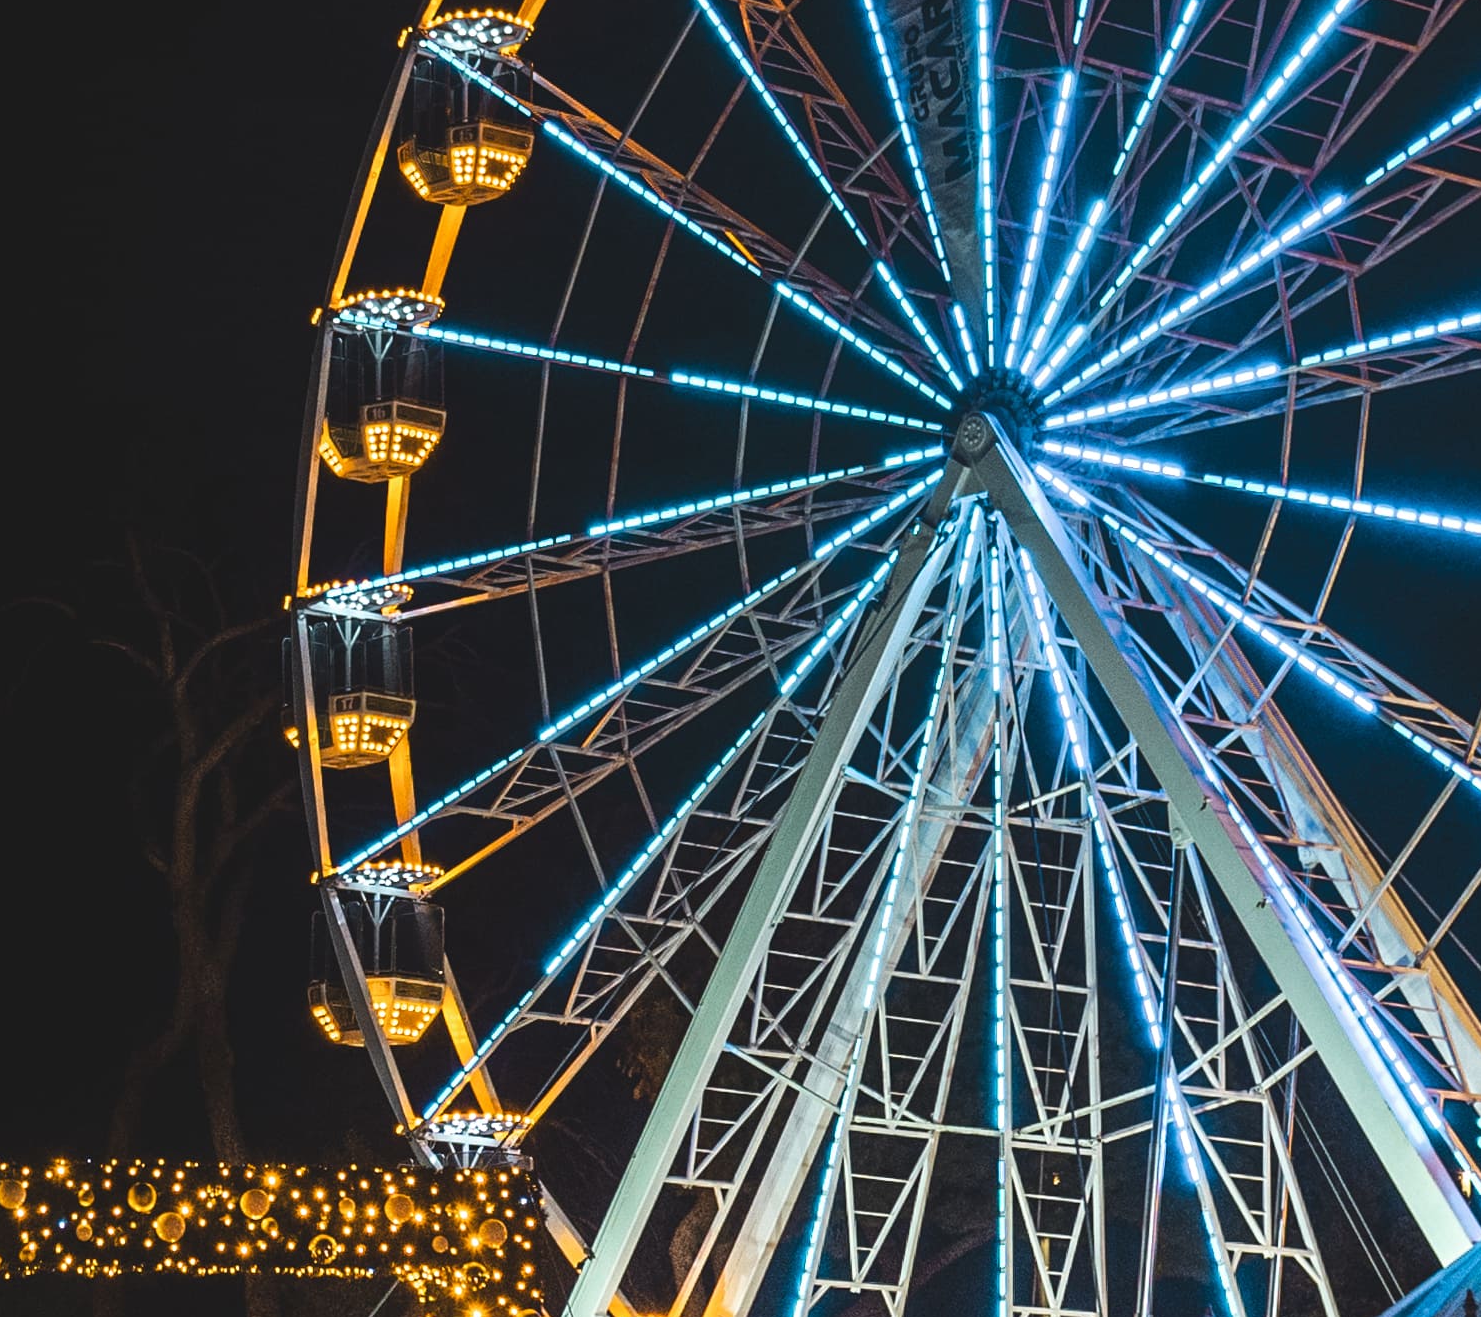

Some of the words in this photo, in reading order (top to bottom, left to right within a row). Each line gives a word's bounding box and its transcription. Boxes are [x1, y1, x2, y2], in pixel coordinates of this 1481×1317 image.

[904, 24, 930, 123] GRUPO
[458, 128, 474, 143] 15
[341, 697, 355, 711] 17
